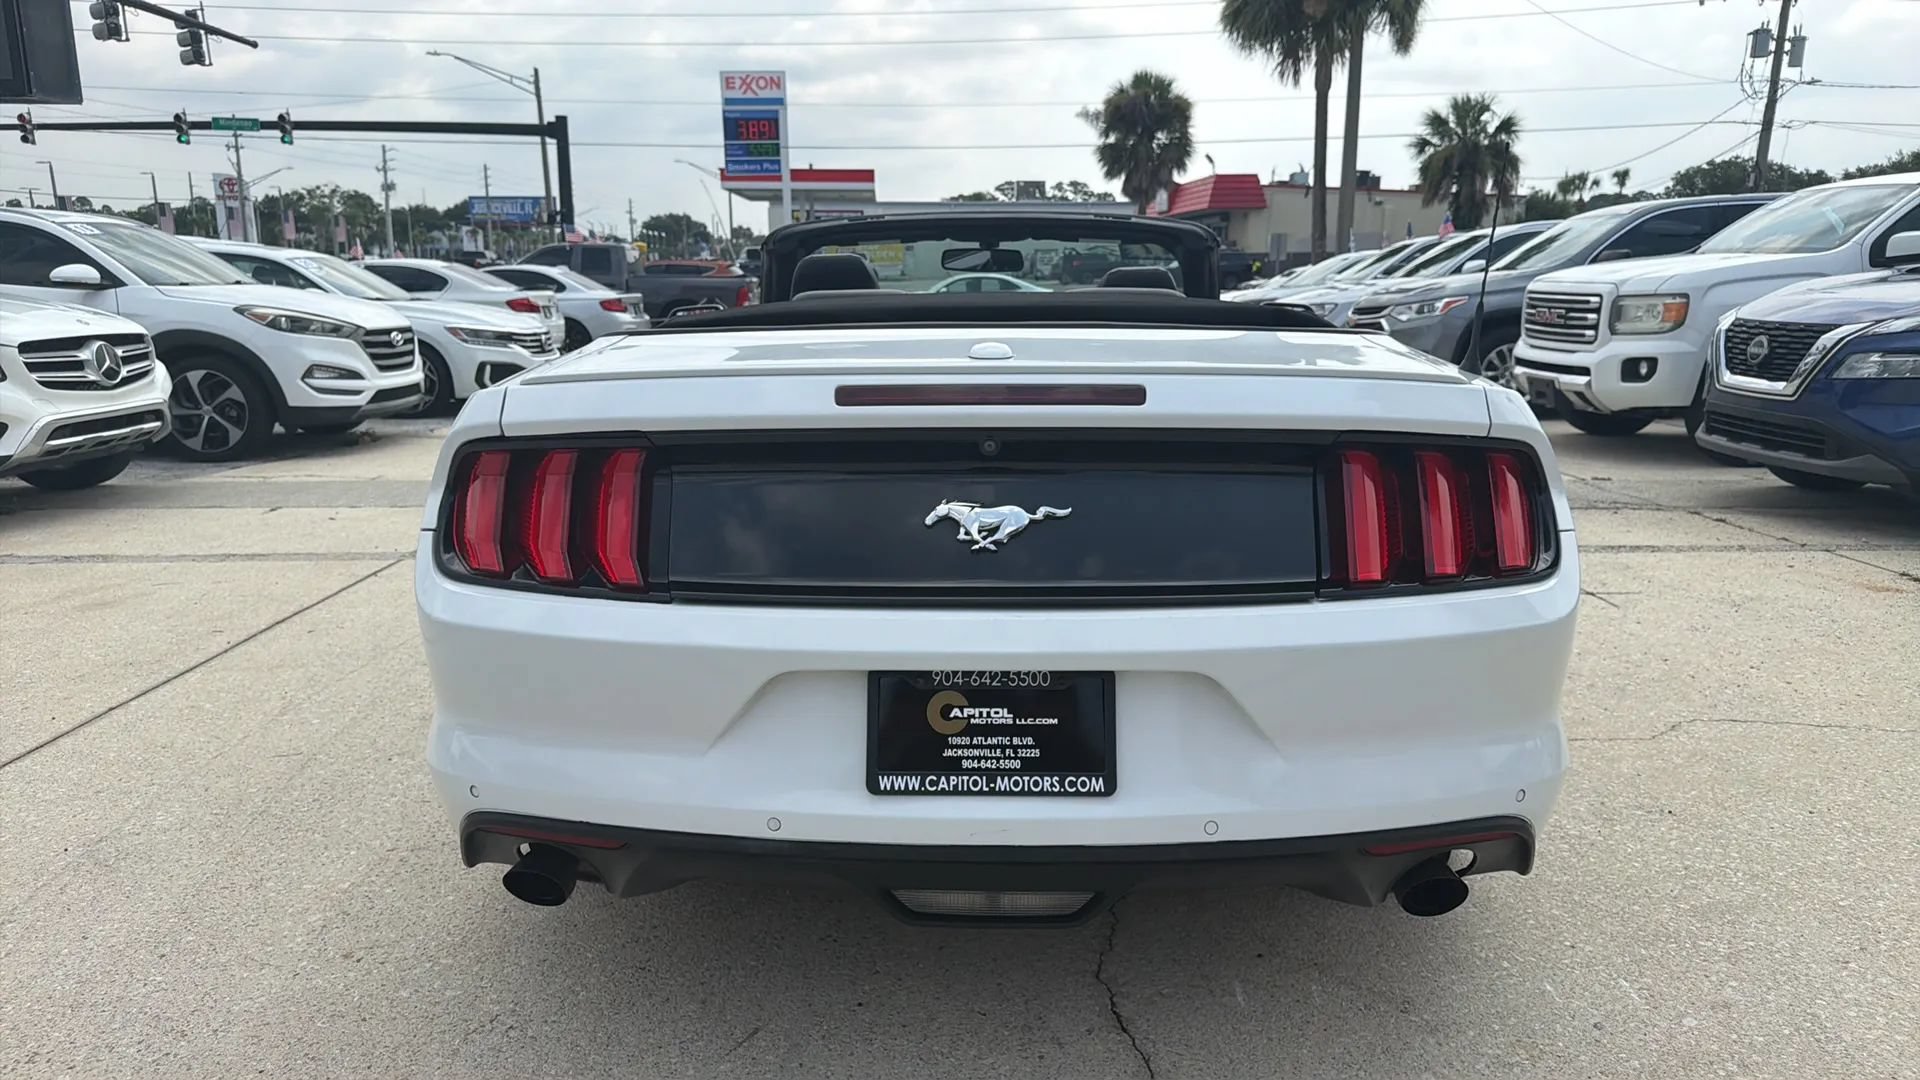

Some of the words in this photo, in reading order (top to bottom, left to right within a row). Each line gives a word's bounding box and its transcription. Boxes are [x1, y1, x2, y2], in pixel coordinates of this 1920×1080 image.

[725, 74, 781, 96] EXXON
[728, 163, 761, 171] Smokers
[763, 162, 780, 171] Plus
[1535, 308, 1566, 324] GMC
[932, 670, 1051, 686] 904-642-5500
[948, 737, 970, 745] 10920
[972, 737, 1011, 745] ATLANTIC
[1012, 737, 1035, 745] BLVD.
[942, 749, 1004, 758] JACKSONVILLE,
[1005, 749, 1015, 757] FL
[1017, 749, 1040, 757] 32225
[961, 759, 1021, 769] 904-642-5500
[878, 775, 1105, 793] WWW.CAPITOL-MOTORS.COM
